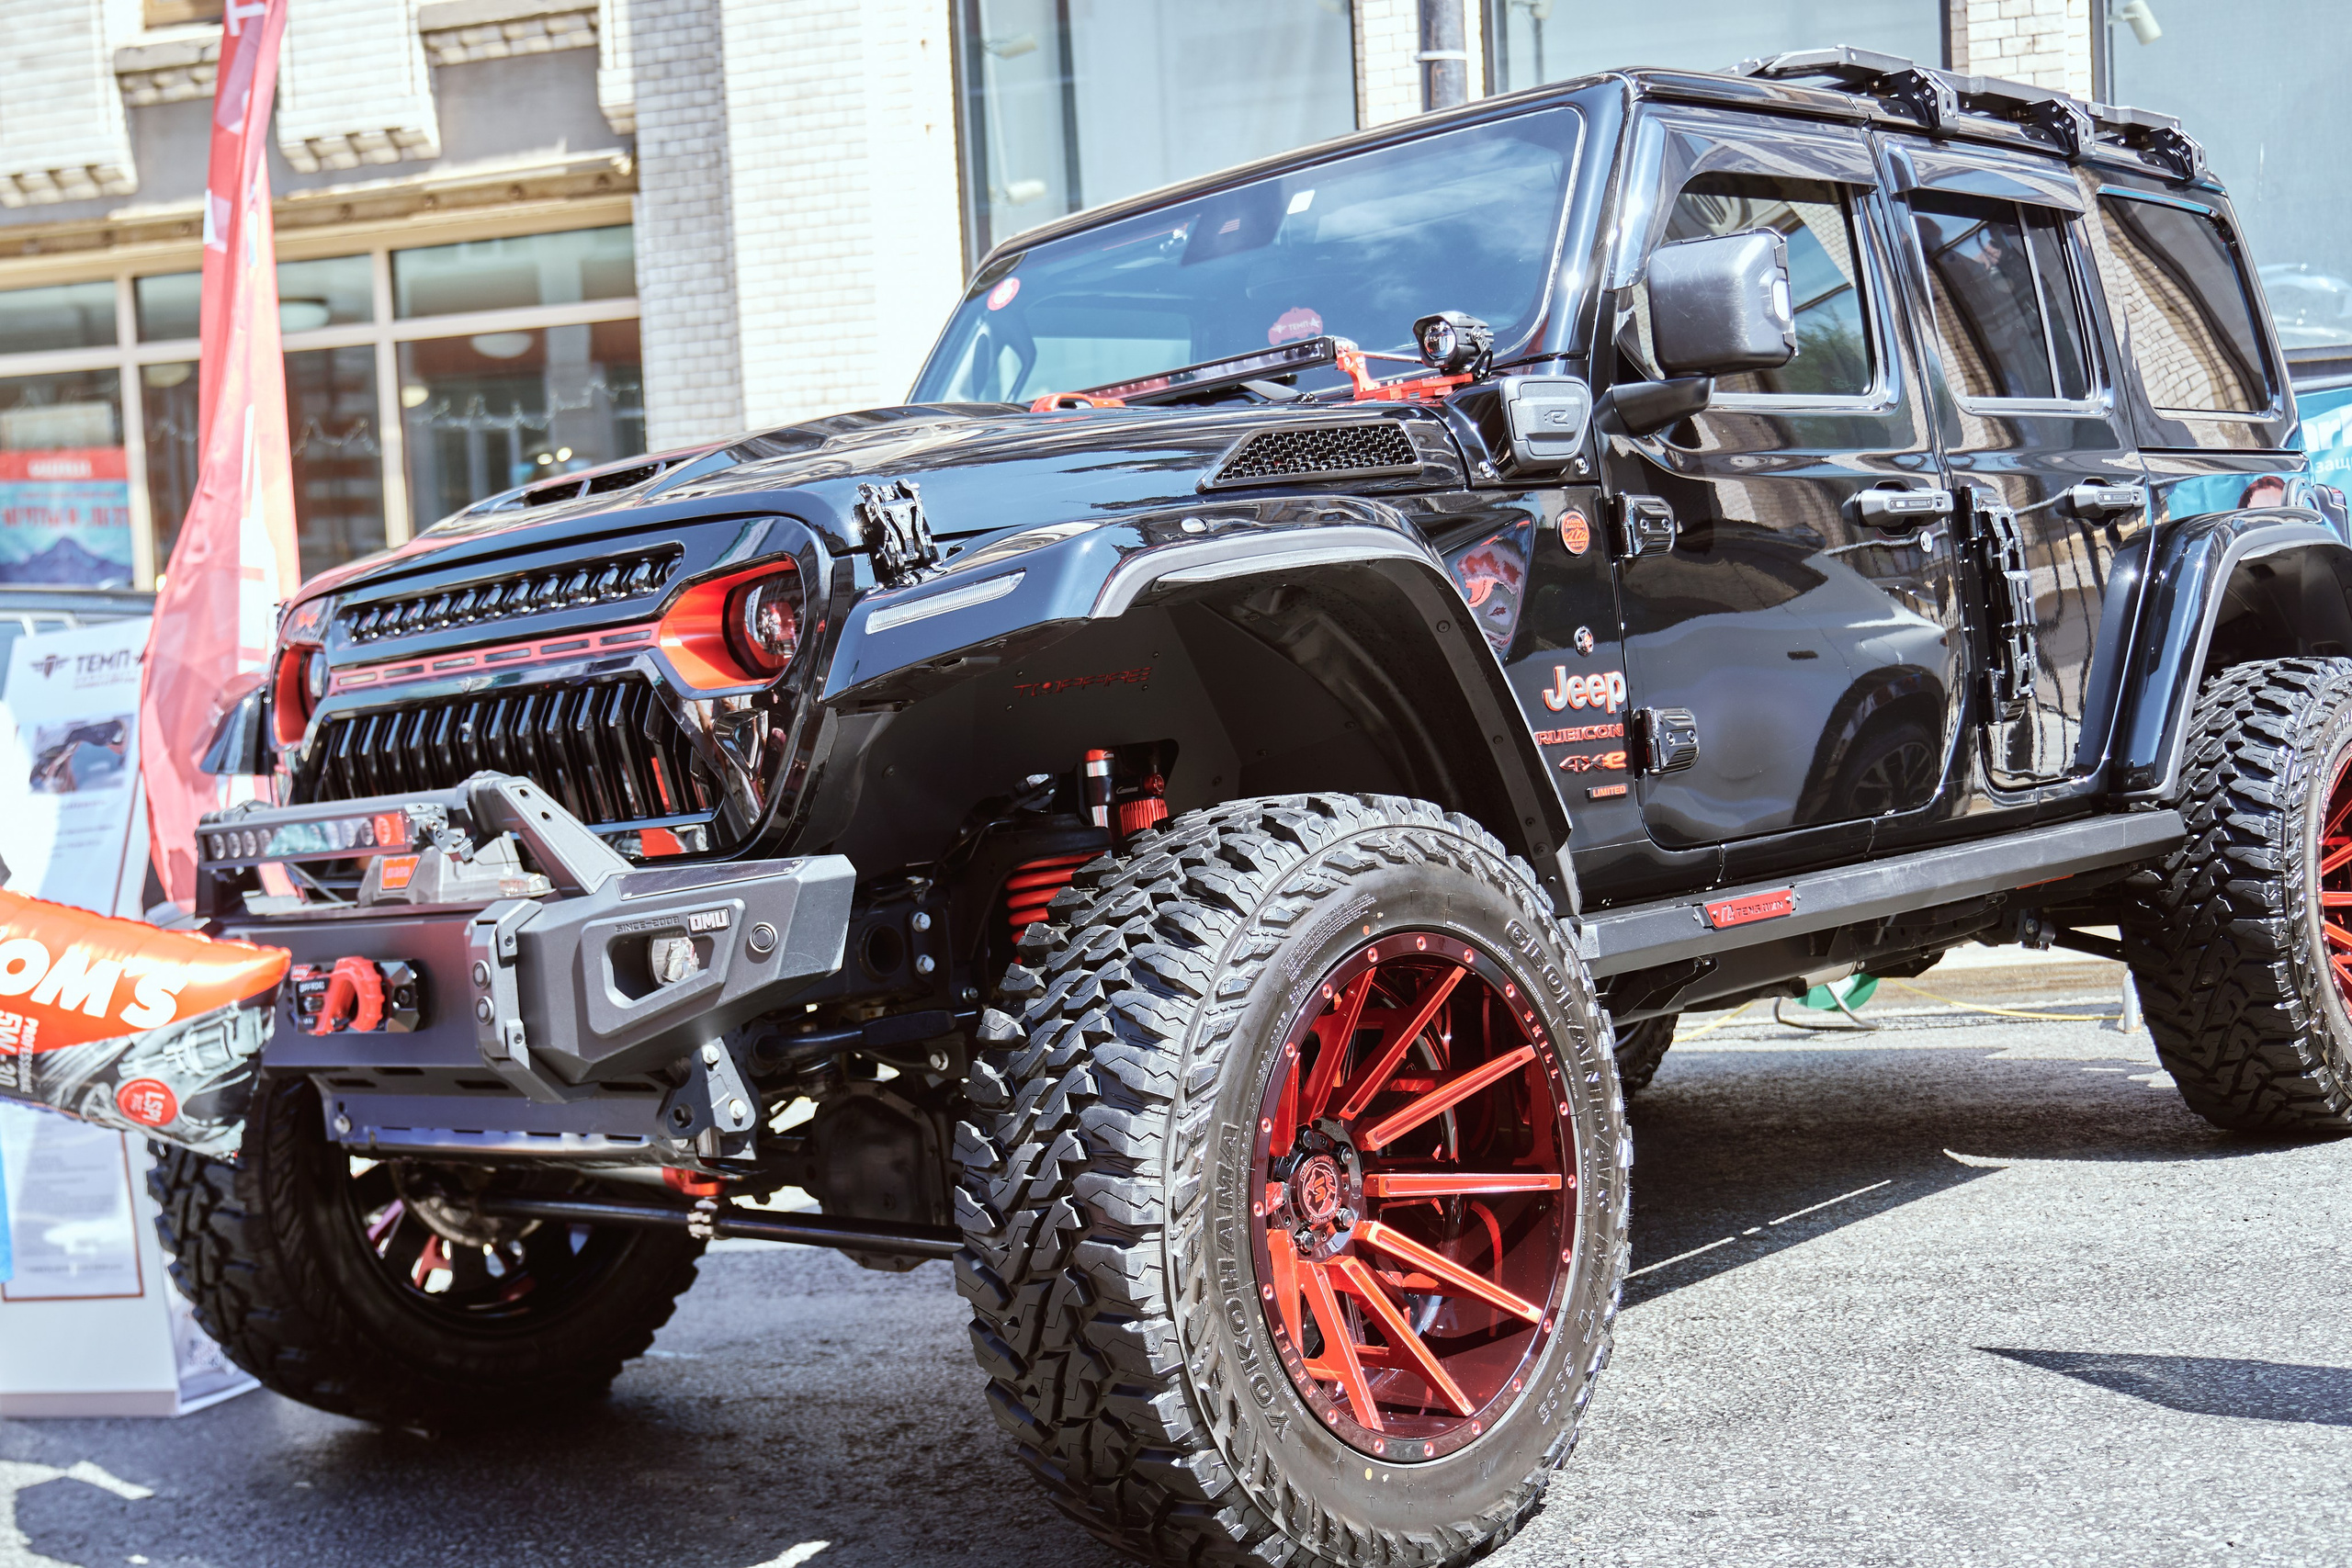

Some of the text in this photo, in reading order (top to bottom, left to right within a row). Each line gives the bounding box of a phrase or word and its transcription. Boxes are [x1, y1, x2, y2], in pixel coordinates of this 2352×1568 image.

[2315, 456, 2352, 474] защ
[1543, 665, 1627, 714] Jeep
[1534, 723, 1624, 745] RUBICON
[1592, 784, 1626, 797] LIMITED
[689, 911, 728, 931] OMU
[0, 925, 188, 1029] OM'S
[1524, 1010, 1559, 1078] SKILL
[1216, 1122, 1290, 1443] YOKOHAMA
[1275, 1323, 1317, 1398] SKILL
